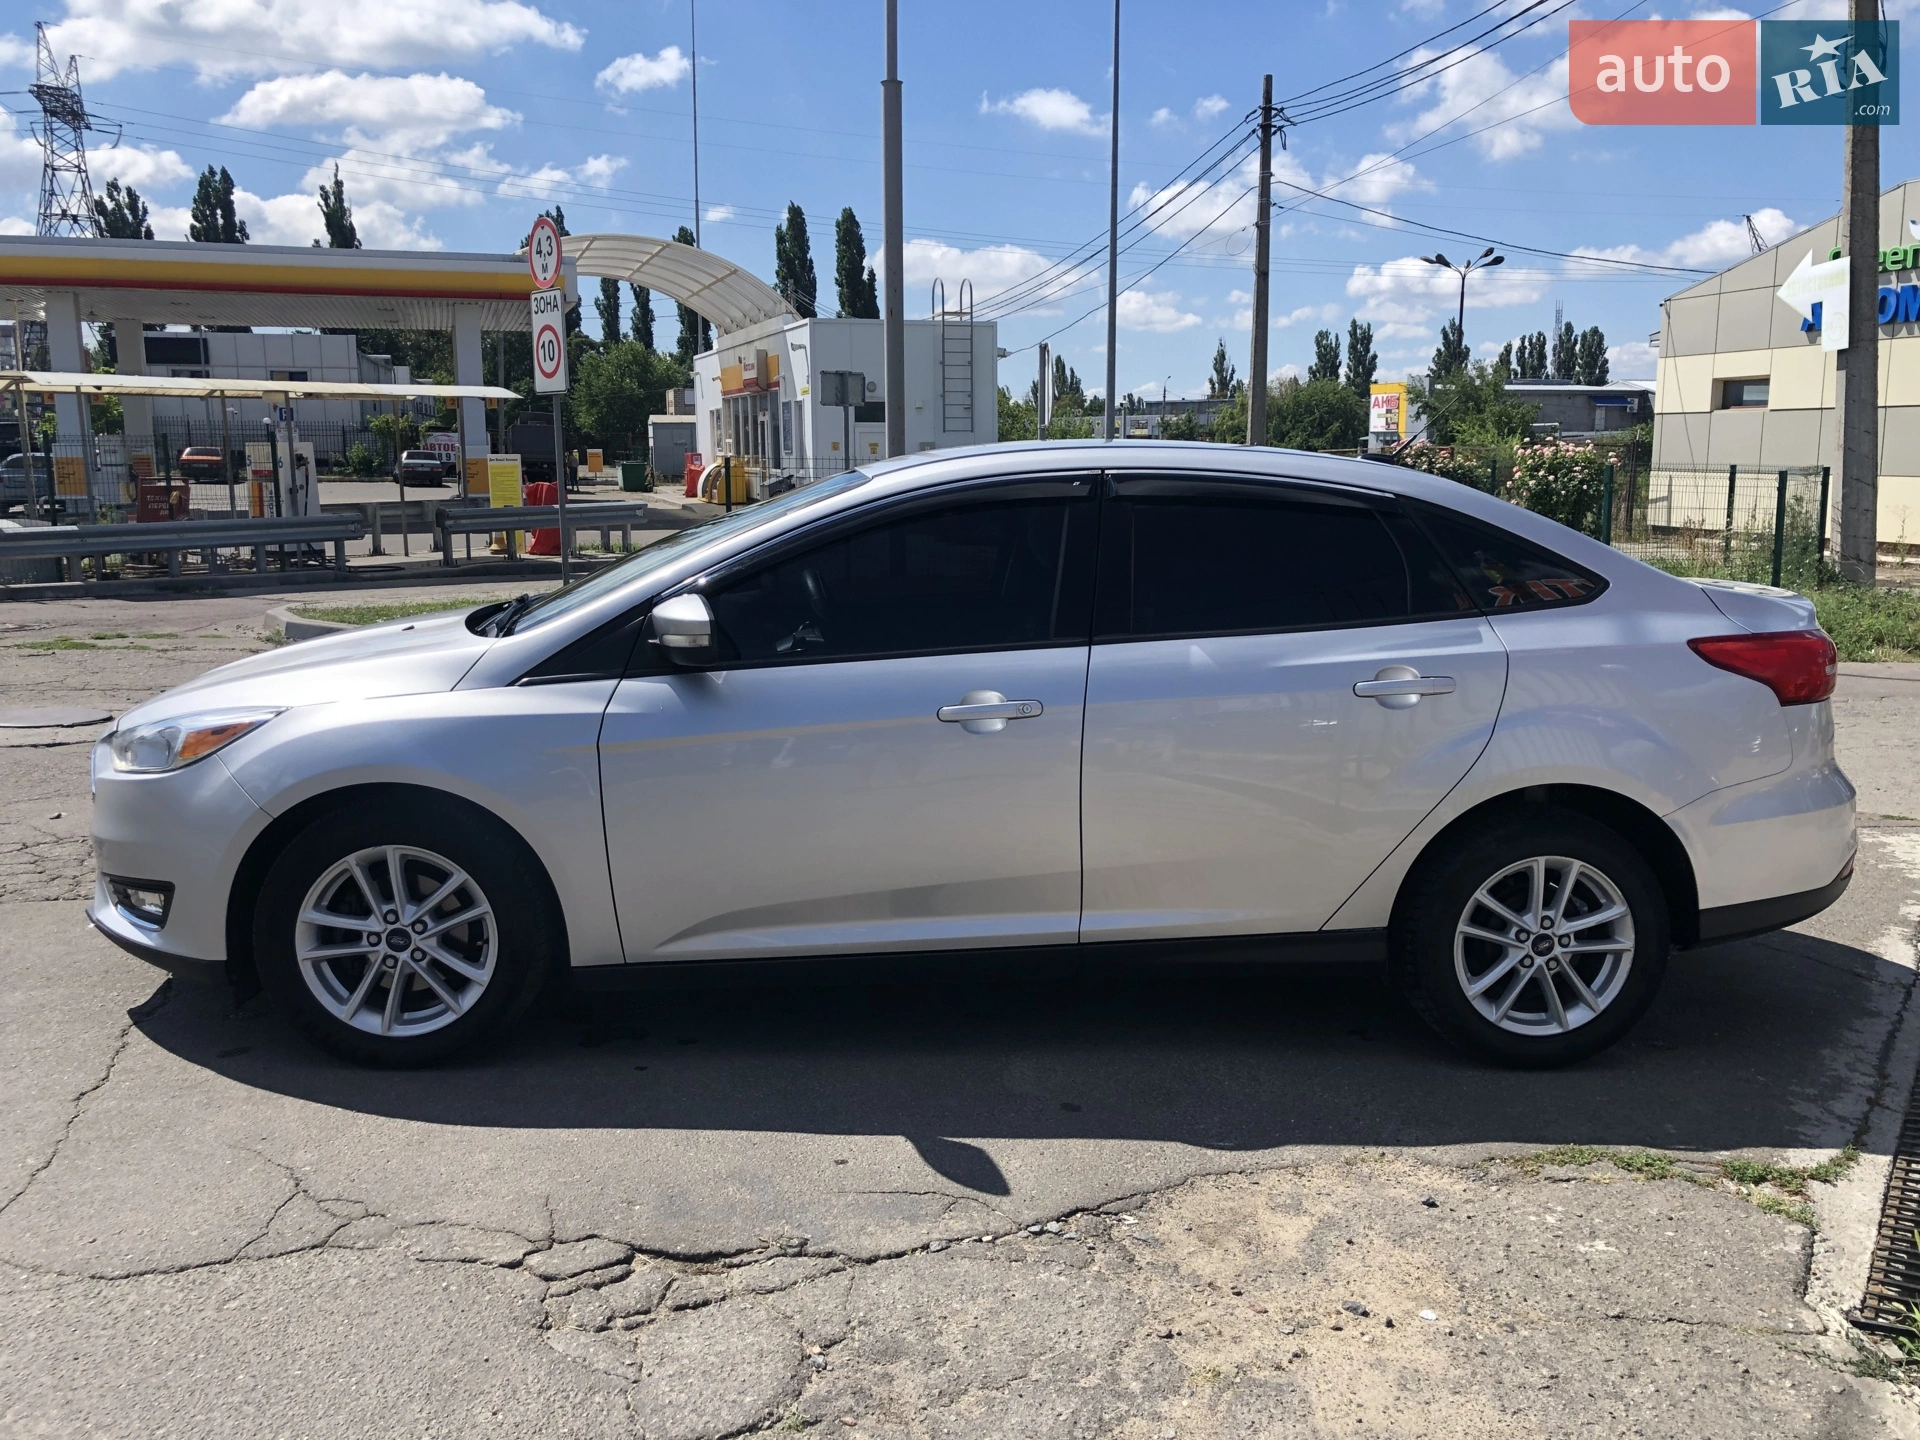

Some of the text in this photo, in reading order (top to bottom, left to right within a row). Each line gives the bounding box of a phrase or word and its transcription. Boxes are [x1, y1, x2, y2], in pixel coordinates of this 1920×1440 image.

[535, 235, 554, 262] 4,3
[533, 294, 560, 315] ЗОНА
[540, 338, 555, 363] 10
[1372, 395, 1398, 409] АКБ
[246, 455, 252, 467] 5
[277, 456, 284, 468] 6
